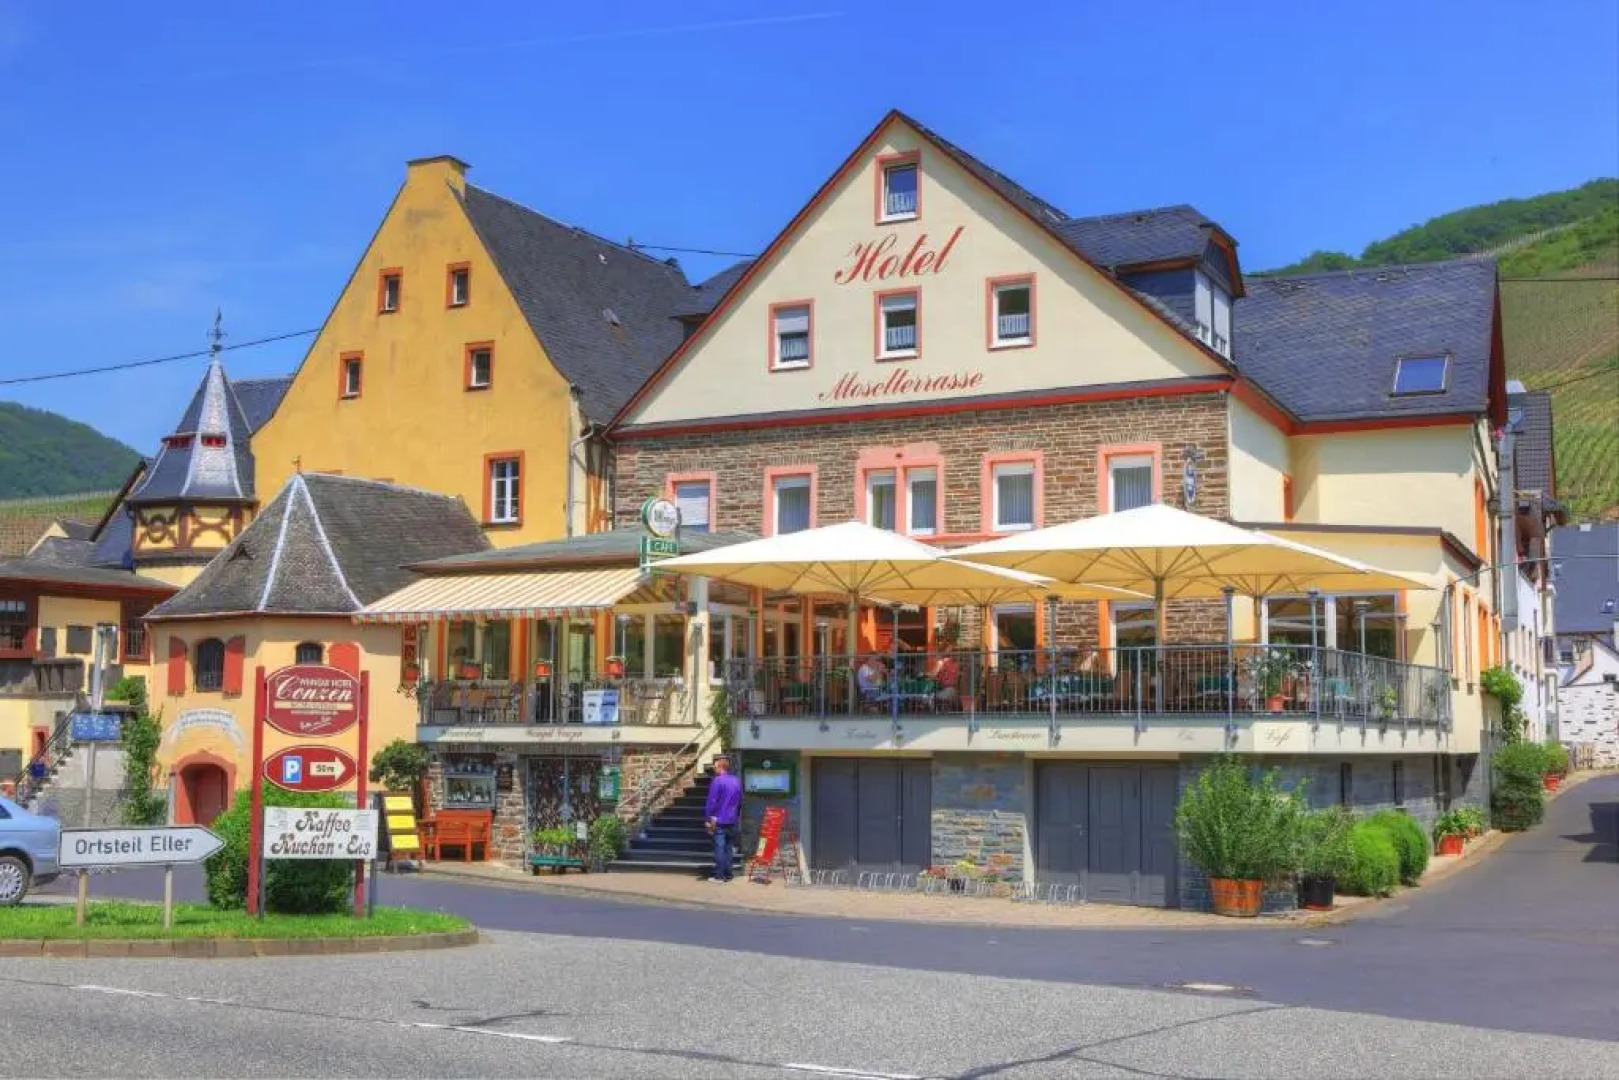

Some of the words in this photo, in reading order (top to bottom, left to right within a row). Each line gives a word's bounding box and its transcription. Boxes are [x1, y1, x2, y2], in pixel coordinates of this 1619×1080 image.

[835, 226, 966, 284] Hotel
[276, 674, 352, 701] Conzen
[285, 760, 299, 779] P
[295, 810, 352, 839] Kaffee
[75, 836, 142, 854] Ortsteil
[151, 835, 194, 852] Eller
[270, 833, 335, 855] Kuchen
[347, 834, 371, 855] Eis
